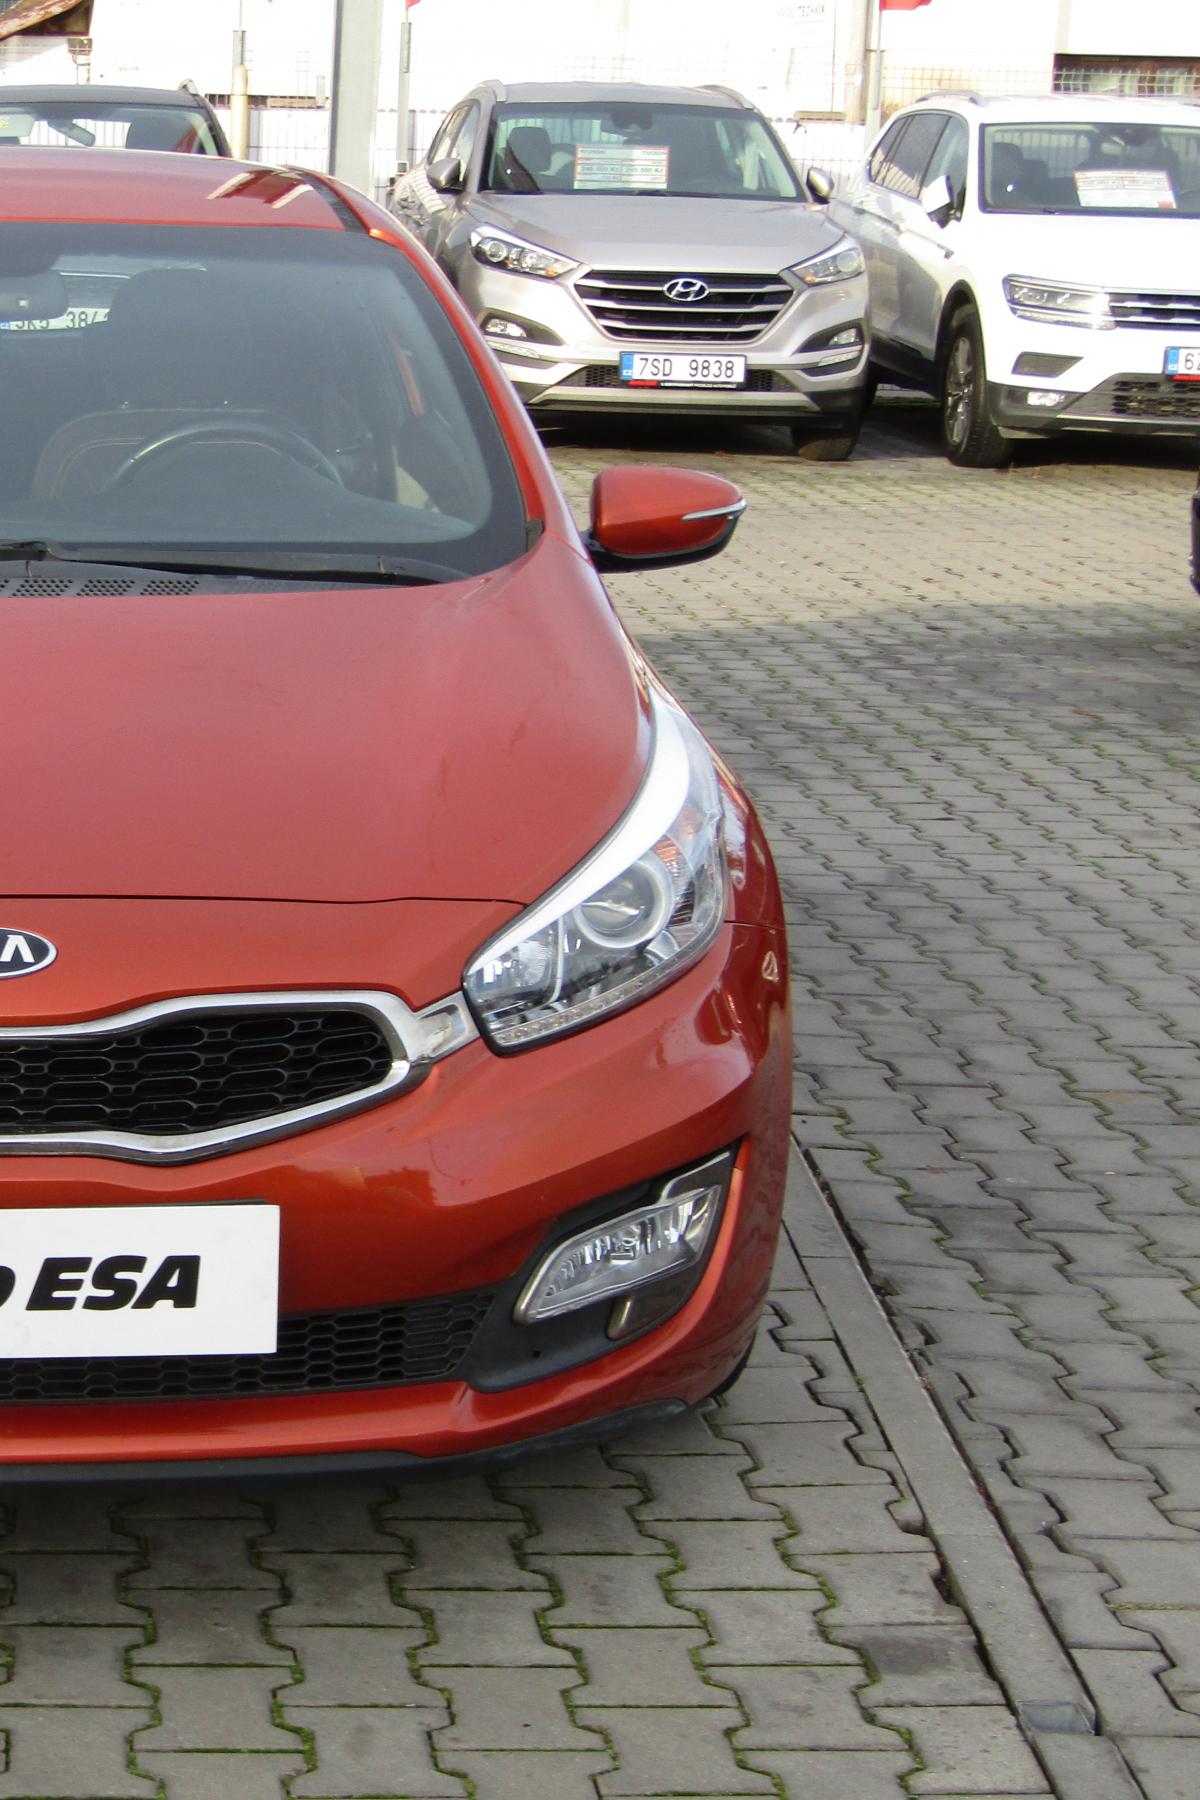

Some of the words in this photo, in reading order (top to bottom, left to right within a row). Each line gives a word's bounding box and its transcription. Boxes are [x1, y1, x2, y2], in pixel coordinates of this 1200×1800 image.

[639, 358, 673, 377] 7SD
[688, 359, 735, 378] 9838
[24, 1254, 201, 1311] ESA
